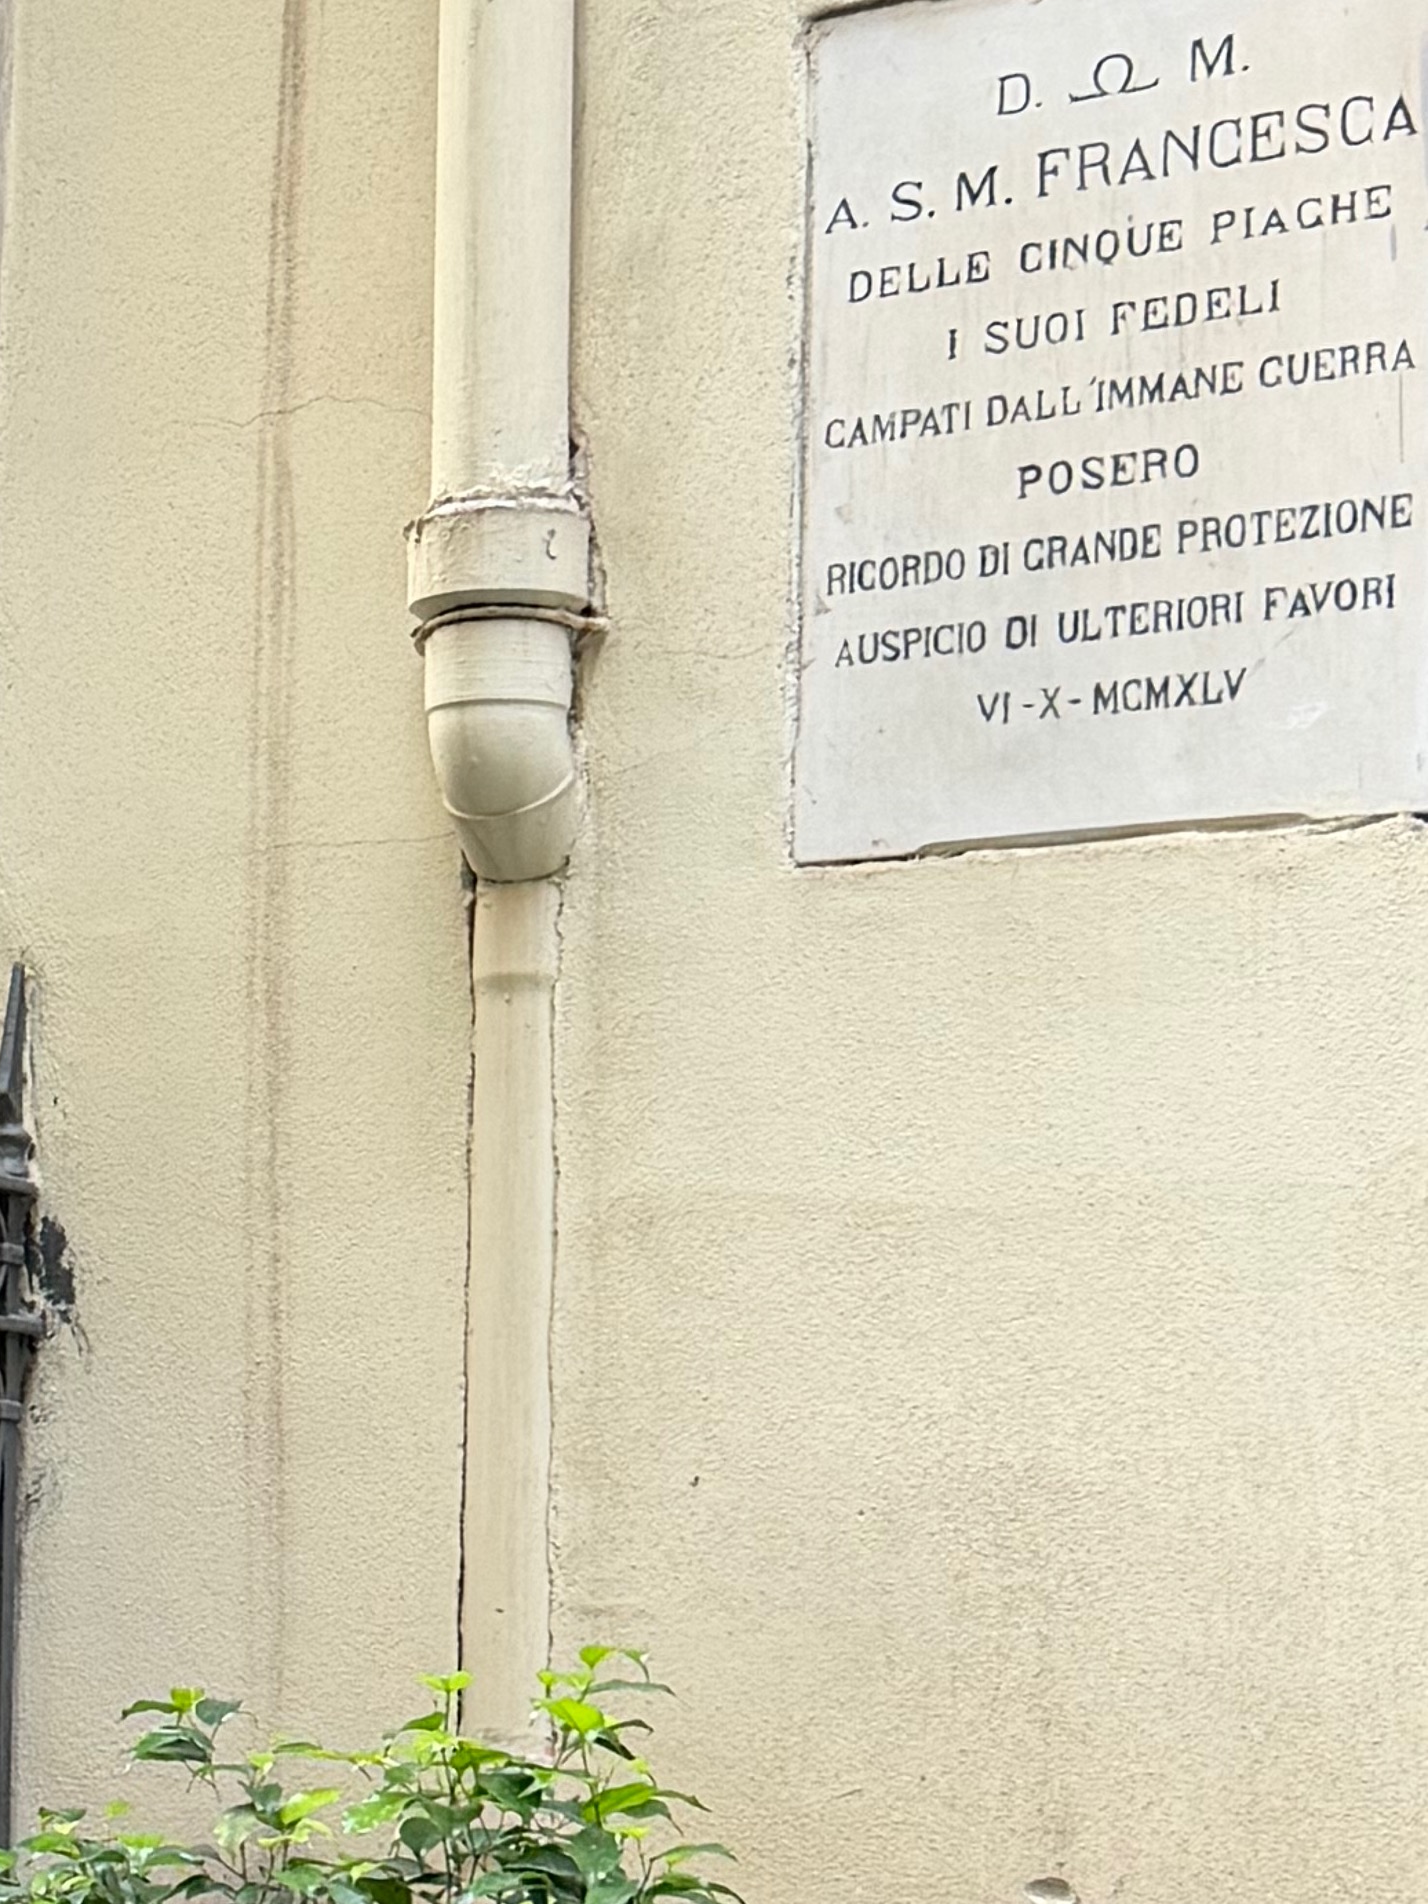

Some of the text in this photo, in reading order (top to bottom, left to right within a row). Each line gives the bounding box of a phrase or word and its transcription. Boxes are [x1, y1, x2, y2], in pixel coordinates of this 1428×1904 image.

[998, 72, 1042, 115] D.
[1190, 34, 1250, 82] M.
[825, 95, 1418, 234] A. S. M. FRANCESCA
[847, 184, 1393, 304] DELLE CINQUE PIAGHE
[946, 278, 1280, 361] I SUOI FEDELI
[824, 400, 972, 450] CAMPATI
[1017, 443, 1201, 500] POSERO
[827, 492, 1414, 596] RICORDO DI GRANDE PROTEZIONE
[835, 573, 1397, 668] AUSPICIO DI ULTERIORI FAVORI
